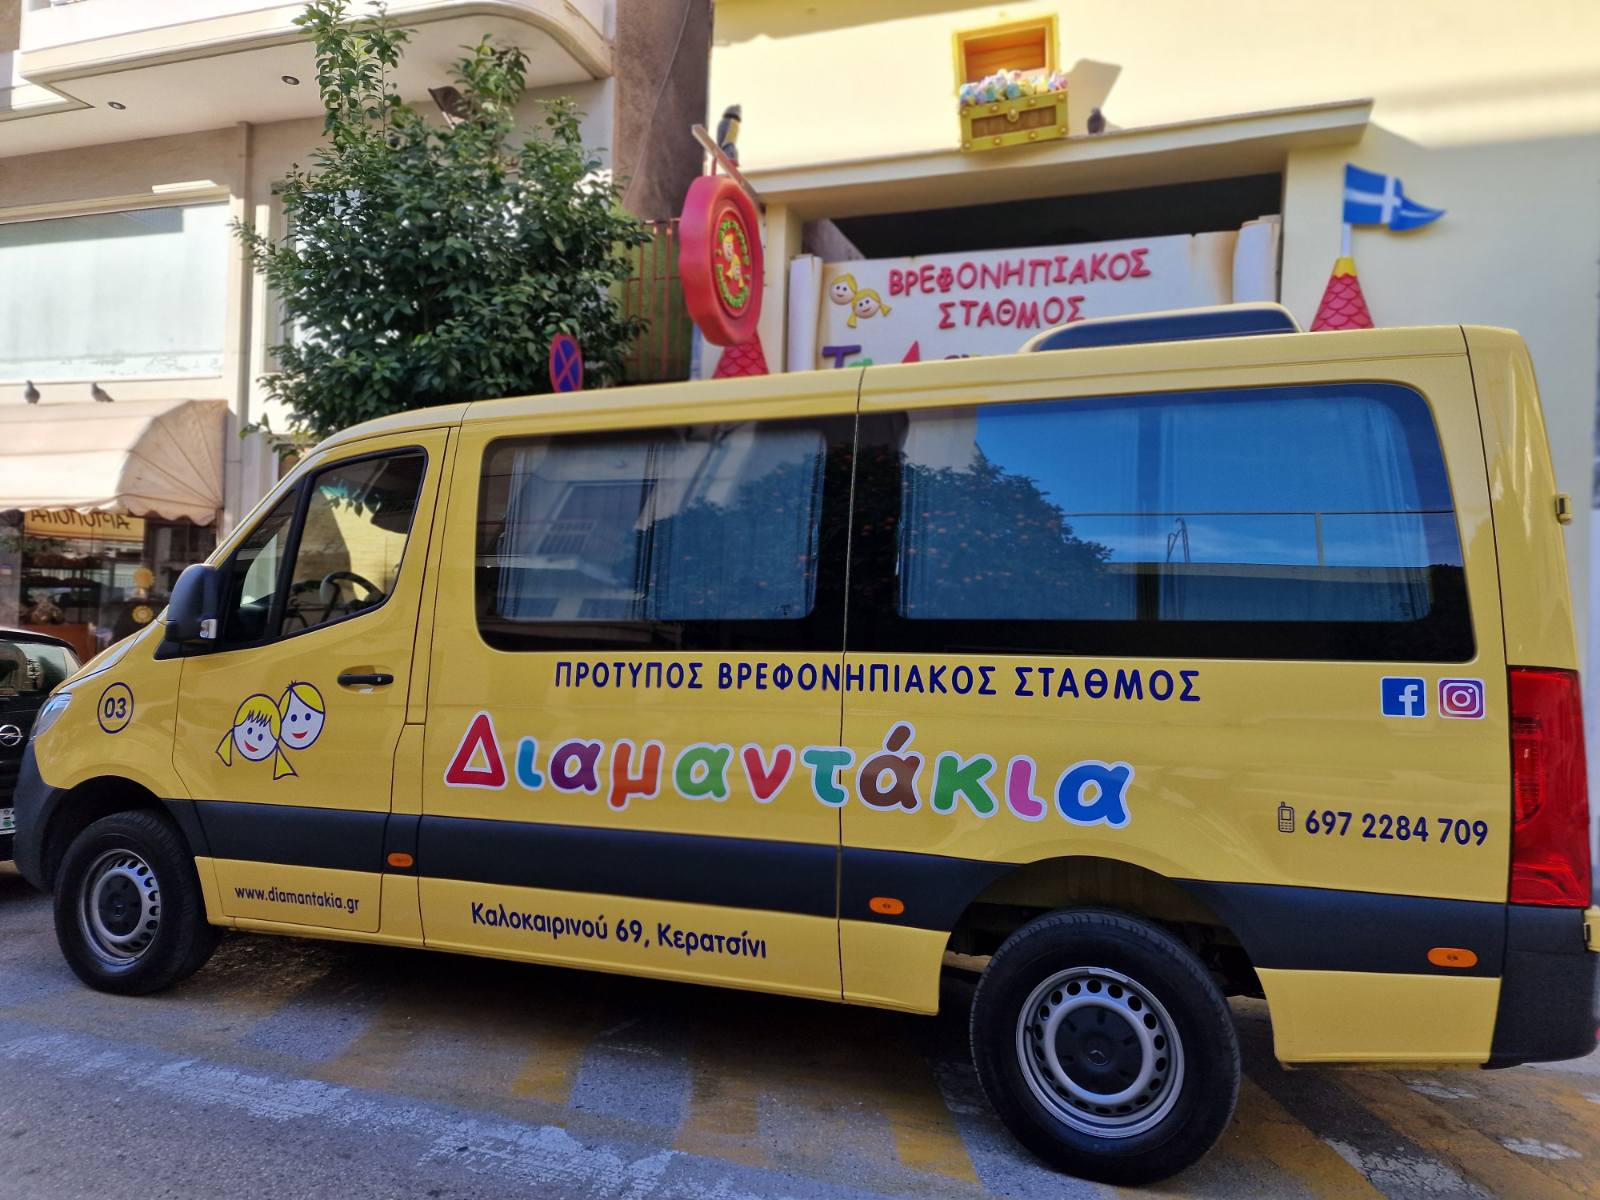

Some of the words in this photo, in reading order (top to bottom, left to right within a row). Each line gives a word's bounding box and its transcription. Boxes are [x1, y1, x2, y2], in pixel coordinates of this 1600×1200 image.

[888, 247, 1152, 297] ΒΡΕΦΟΝΗΠΙΑΚΟΣ
[938, 295, 1086, 329] ΣΤΑΘΜΟΣ
[555, 661, 703, 689] ΠΡΟΤΥΠΟΣ
[717, 662, 997, 695] ΒΡΕΦΟΝΗΠΙΑΚΟΣ
[1014, 666, 1201, 702] ΣΤΑΘΜΟΣ
[104, 697, 126, 719] 03
[445, 710, 1135, 829] Διαμαντάκια
[1305, 809, 1352, 836] 697
[1361, 812, 1428, 842] 2284
[1437, 818, 1488, 846] 709
[234, 886, 359, 914] www.diamantakia.gr
[471, 902, 608, 940] Καλοκαιρινού
[615, 918, 650, 948] 69,
[657, 922, 767, 959] Κερατσίνι
